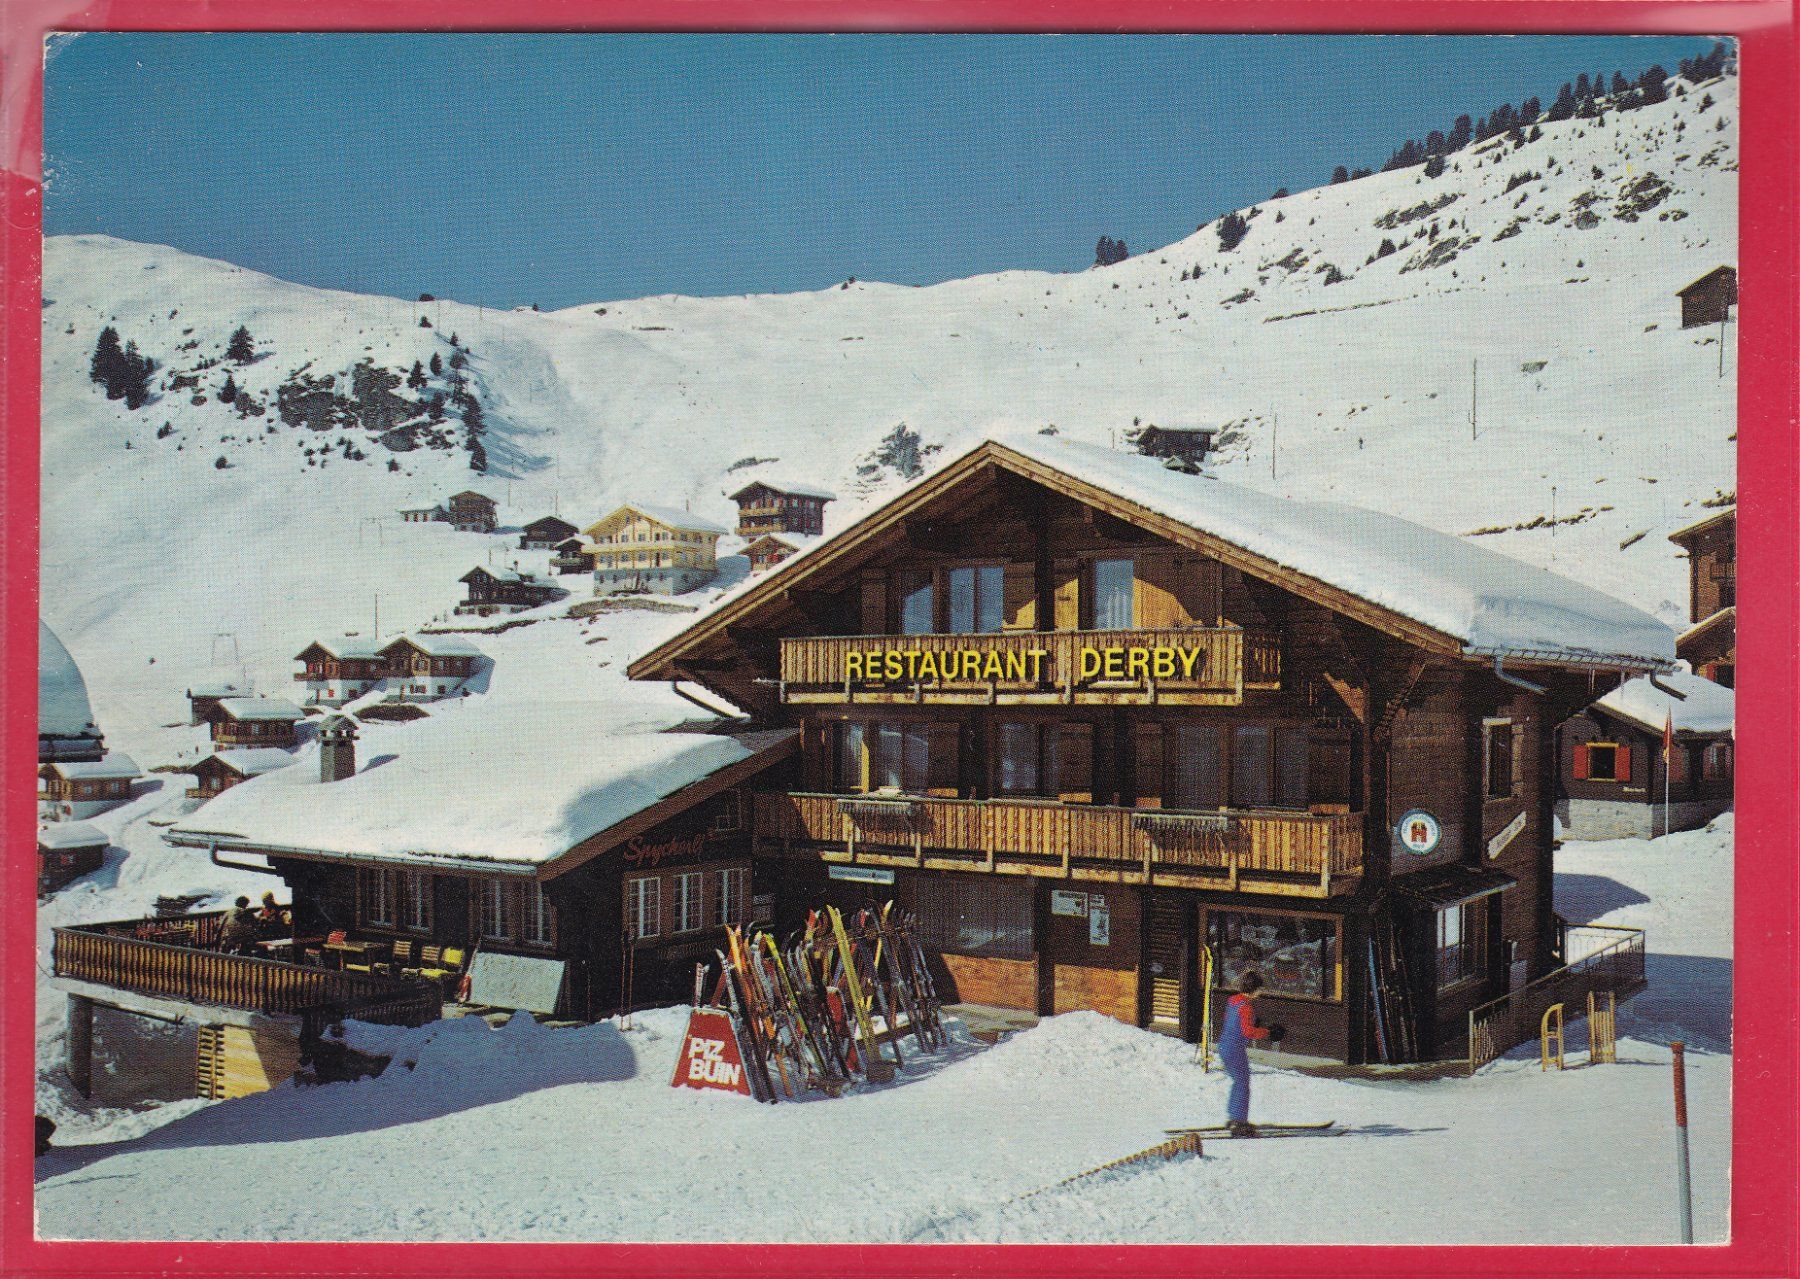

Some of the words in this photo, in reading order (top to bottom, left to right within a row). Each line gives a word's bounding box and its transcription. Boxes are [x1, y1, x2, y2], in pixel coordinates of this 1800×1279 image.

[845, 649, 1047, 680] RESTAURANT
[1079, 647, 1203, 679] DERBY
[688, 1037, 725, 1061] PIZ
[688, 1058, 741, 1086] BUIN
